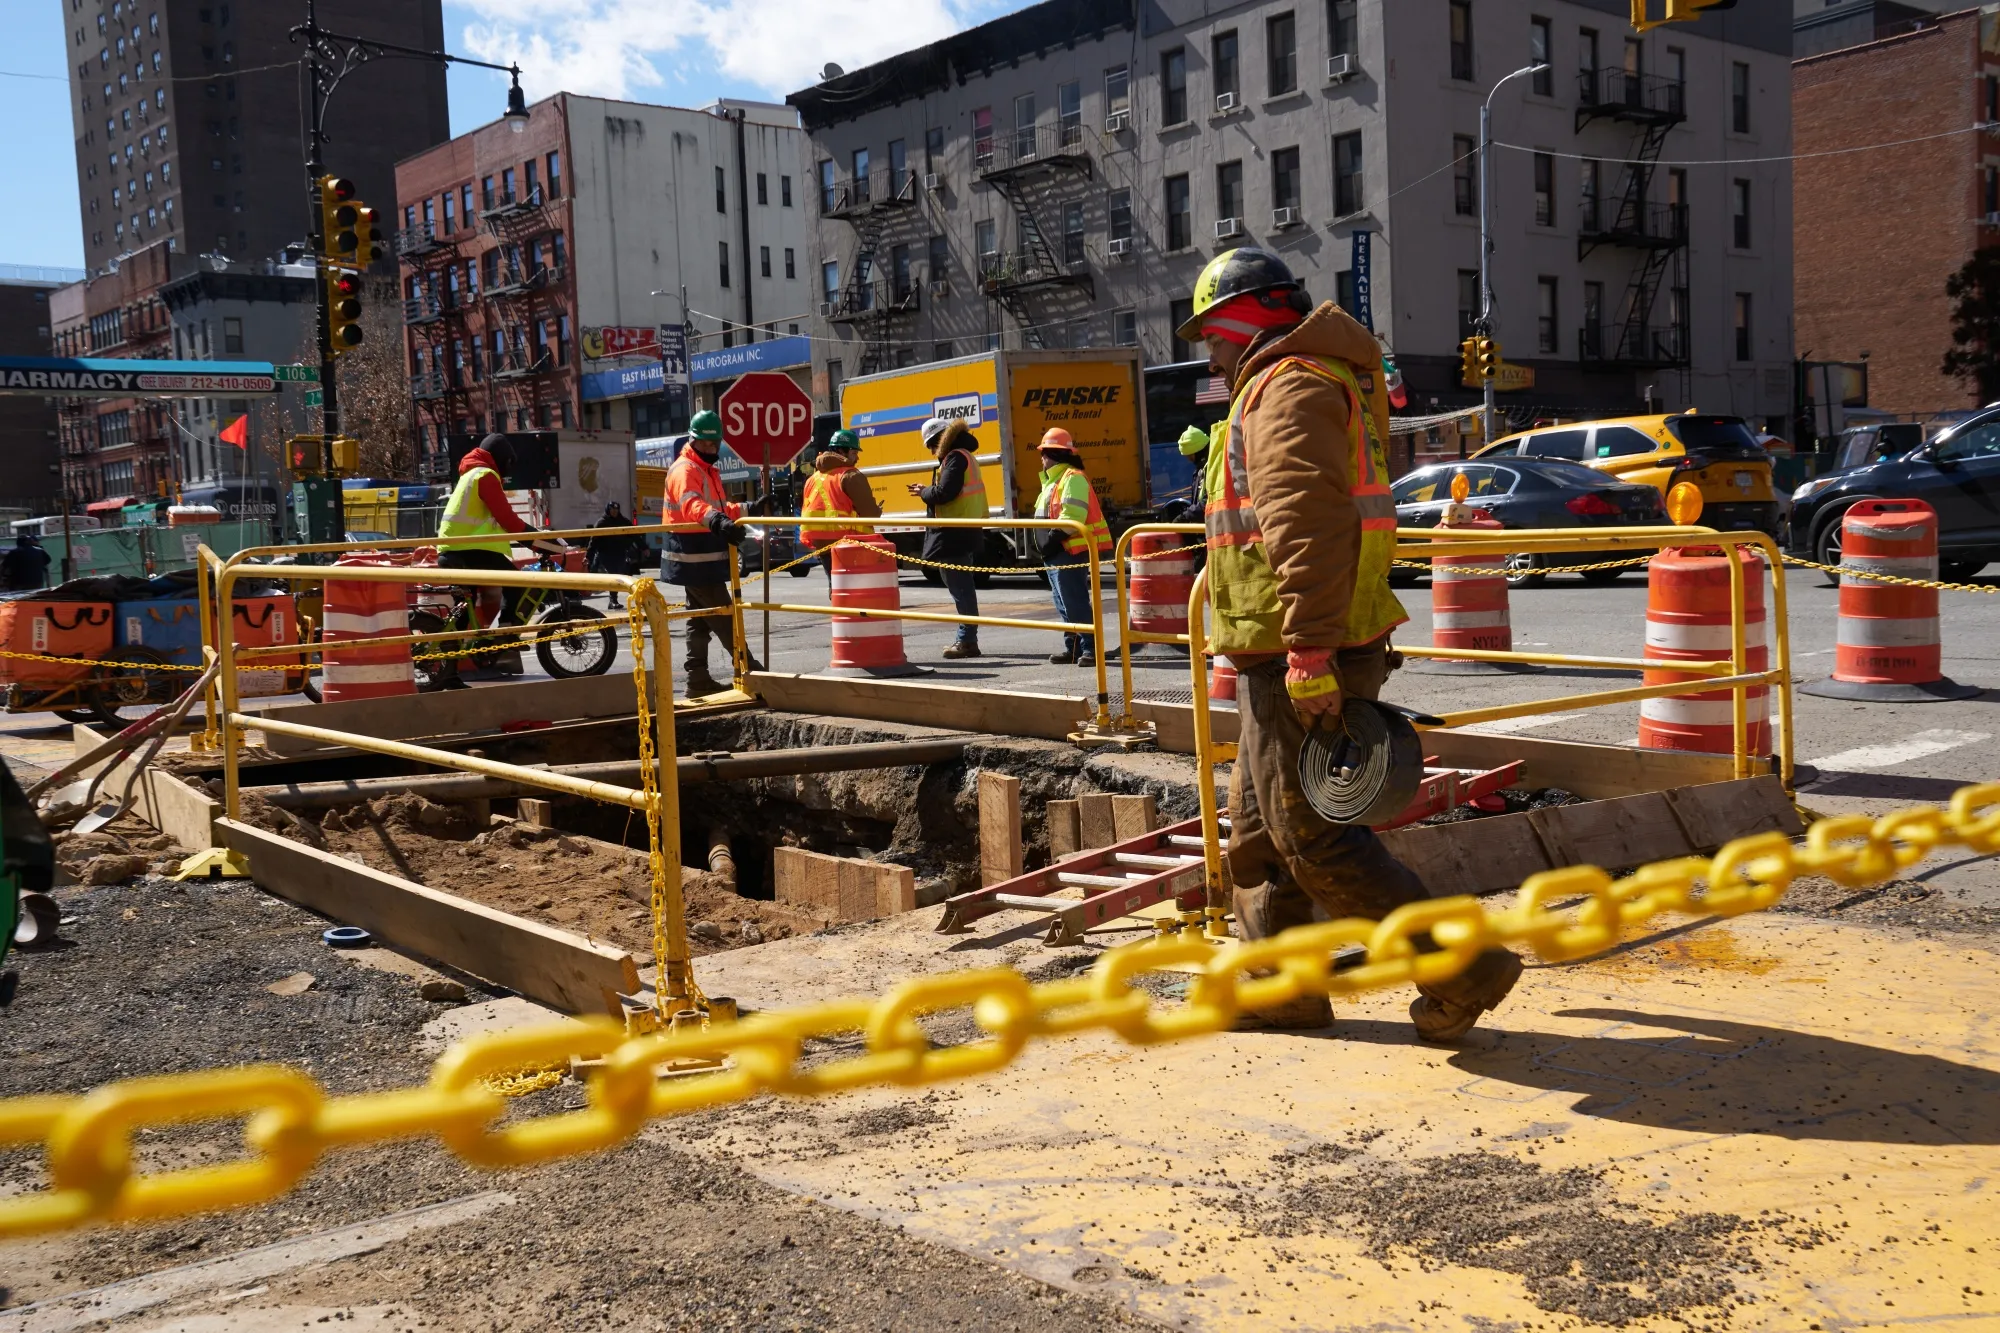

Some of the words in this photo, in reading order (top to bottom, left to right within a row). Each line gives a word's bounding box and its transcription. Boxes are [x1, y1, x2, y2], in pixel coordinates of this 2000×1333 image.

[1357, 234, 1368, 328] RESTAURAN
[275, 367, 280, 380] E
[286, 367, 306, 380] 106
[621, 372, 639, 384] EAST
[640, 367, 663, 380] HARLE
[690, 361, 704, 372] RIAL
[706, 353, 744, 369] PROGRAM
[746, 348, 763, 361] INC.
[0, 370, 133, 389] ARMACY
[141, 376, 156, 387] FREE
[158, 376, 186, 388] DELIVERY
[191, 377, 271, 390] 212-410-0509
[1022, 385, 1121, 407] PENSKE
[727, 402, 807, 437] STOP
[937, 404, 976, 420] PENSKE
[1044, 410, 1069, 421] Truck
[1071, 408, 1102, 420] Rental
[866, 427, 876, 436] Way
[1101, 438, 1126, 446] Rentals
[1472, 636, 1499, 649] NYC
